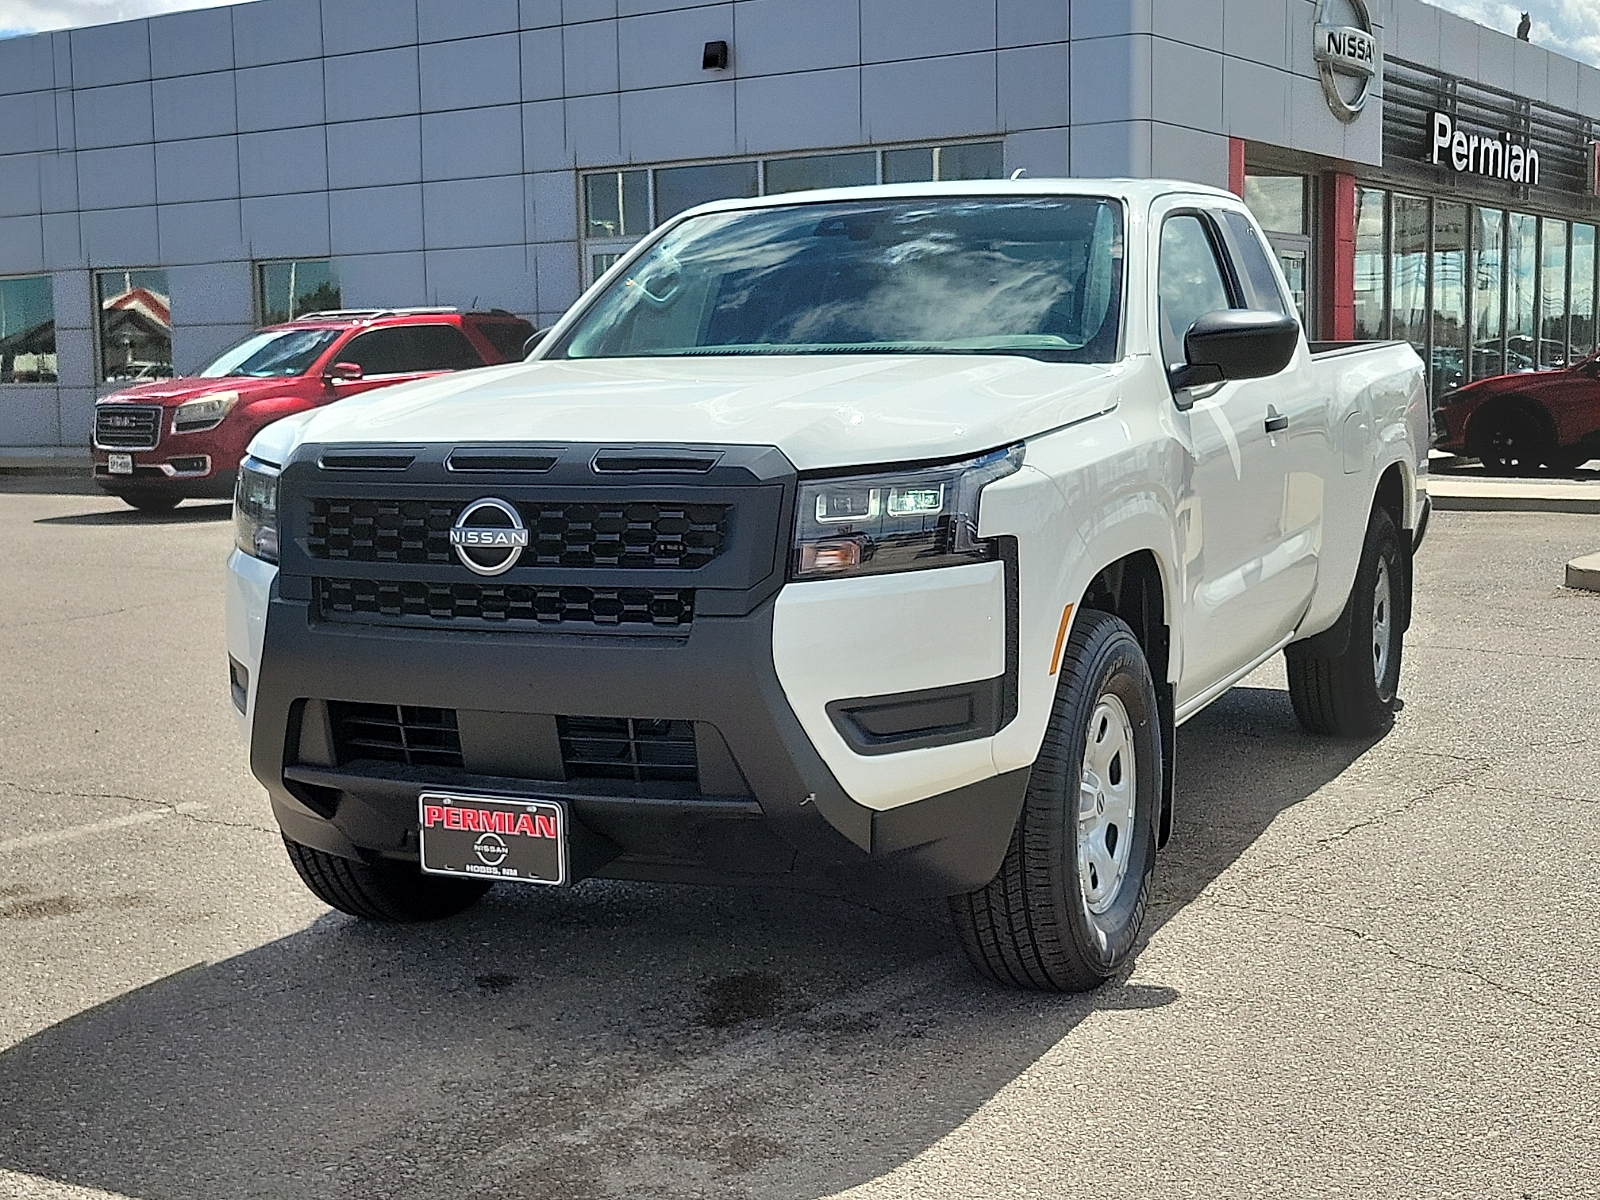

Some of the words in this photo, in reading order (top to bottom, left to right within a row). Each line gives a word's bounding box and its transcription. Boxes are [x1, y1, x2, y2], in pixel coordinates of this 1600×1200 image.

[1327, 31, 1375, 64] NISSA
[1432, 111, 1539, 185] Permian
[450, 530, 525, 544] NISSAN
[424, 805, 556, 839] PERMIAN
[474, 844, 508, 854] NISSAN
[502, 867, 518, 877] NM
